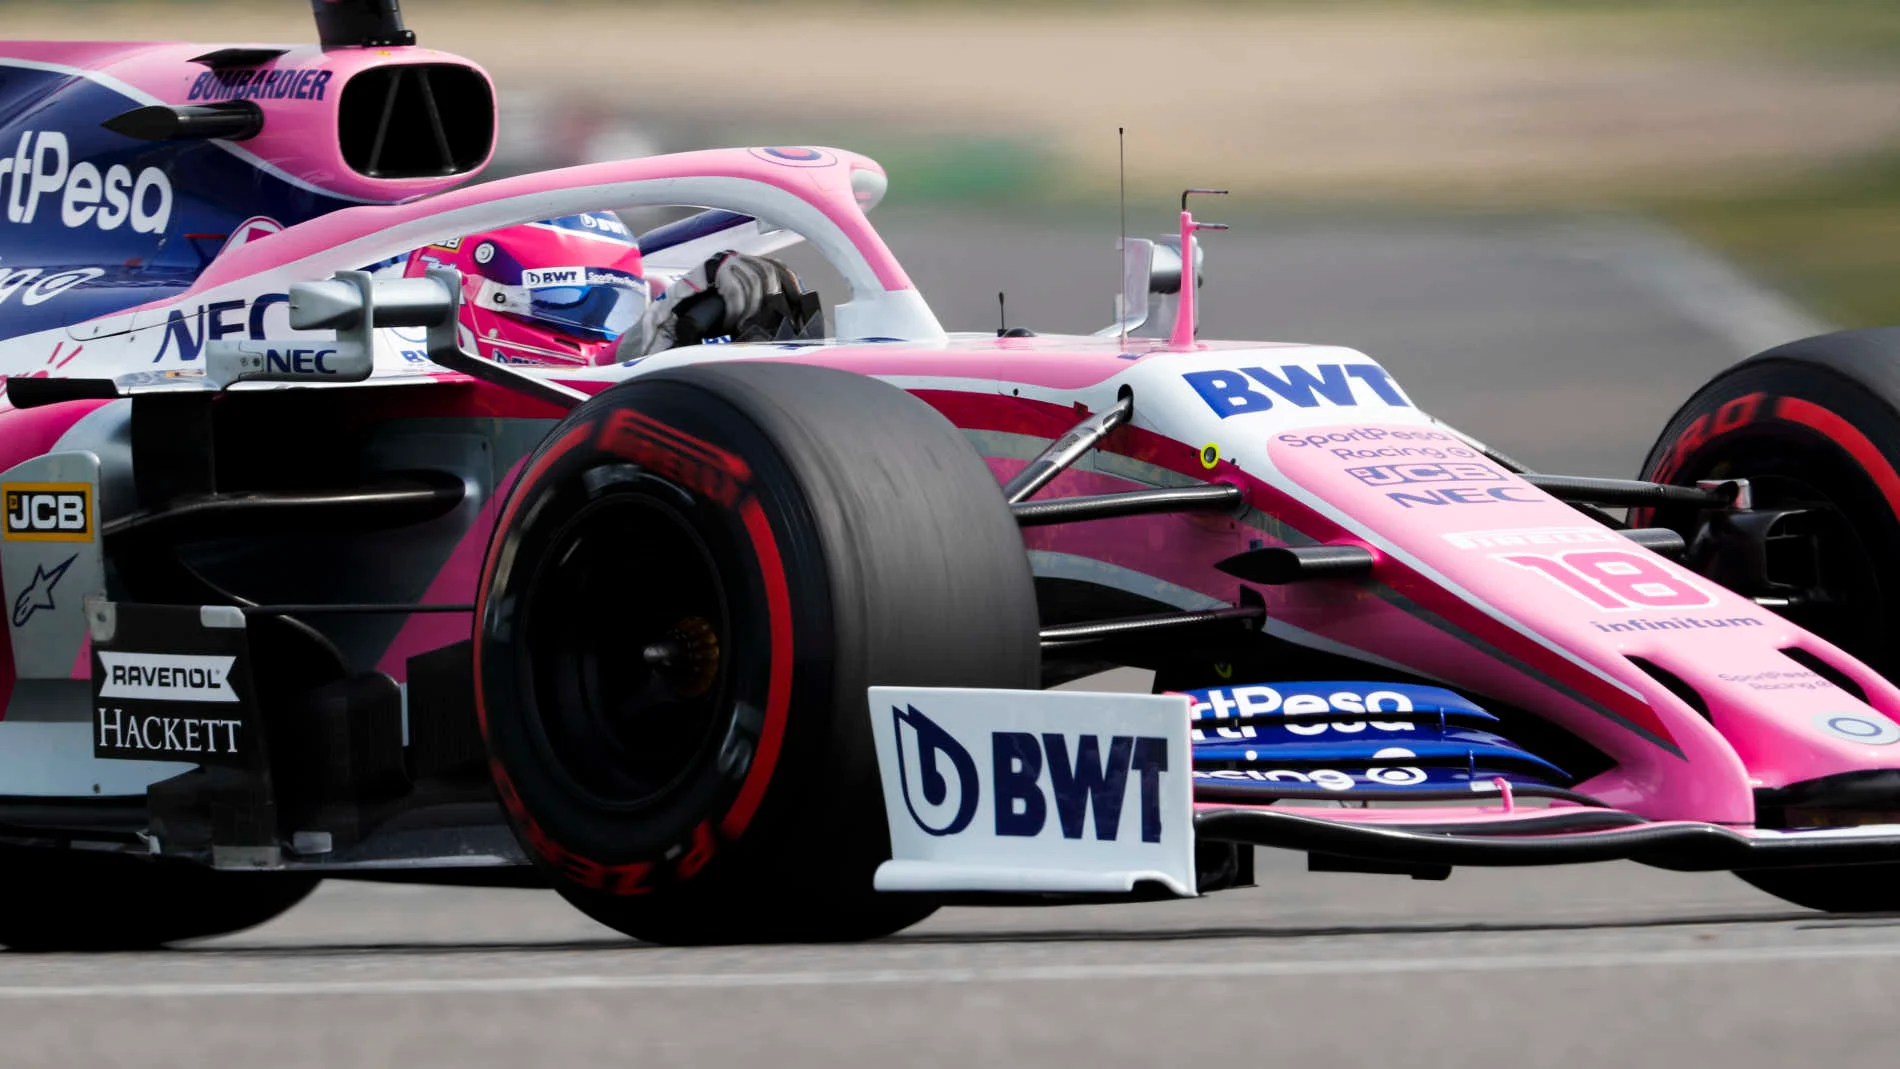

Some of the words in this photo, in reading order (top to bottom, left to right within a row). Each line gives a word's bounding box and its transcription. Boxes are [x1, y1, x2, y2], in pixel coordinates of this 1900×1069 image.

[187, 69, 333, 101] BOMBARDIER
[542, 271, 577, 283] BWT
[266, 350, 337, 374] NEC
[1182, 364, 1411, 419] BWT
[1278, 427, 1452, 448] SportPesa
[1331, 446, 1448, 460] Racing
[1345, 464, 1505, 486] JCB
[1386, 487, 1545, 508] NEC
[9, 495, 85, 530] JCB
[1492, 550, 1718, 612] 18
[1591, 615, 1764, 633] infinitum
[112, 665, 221, 689] RAVENOL
[98, 708, 242, 753] HACKETT
[992, 731, 1168, 843] BWT
